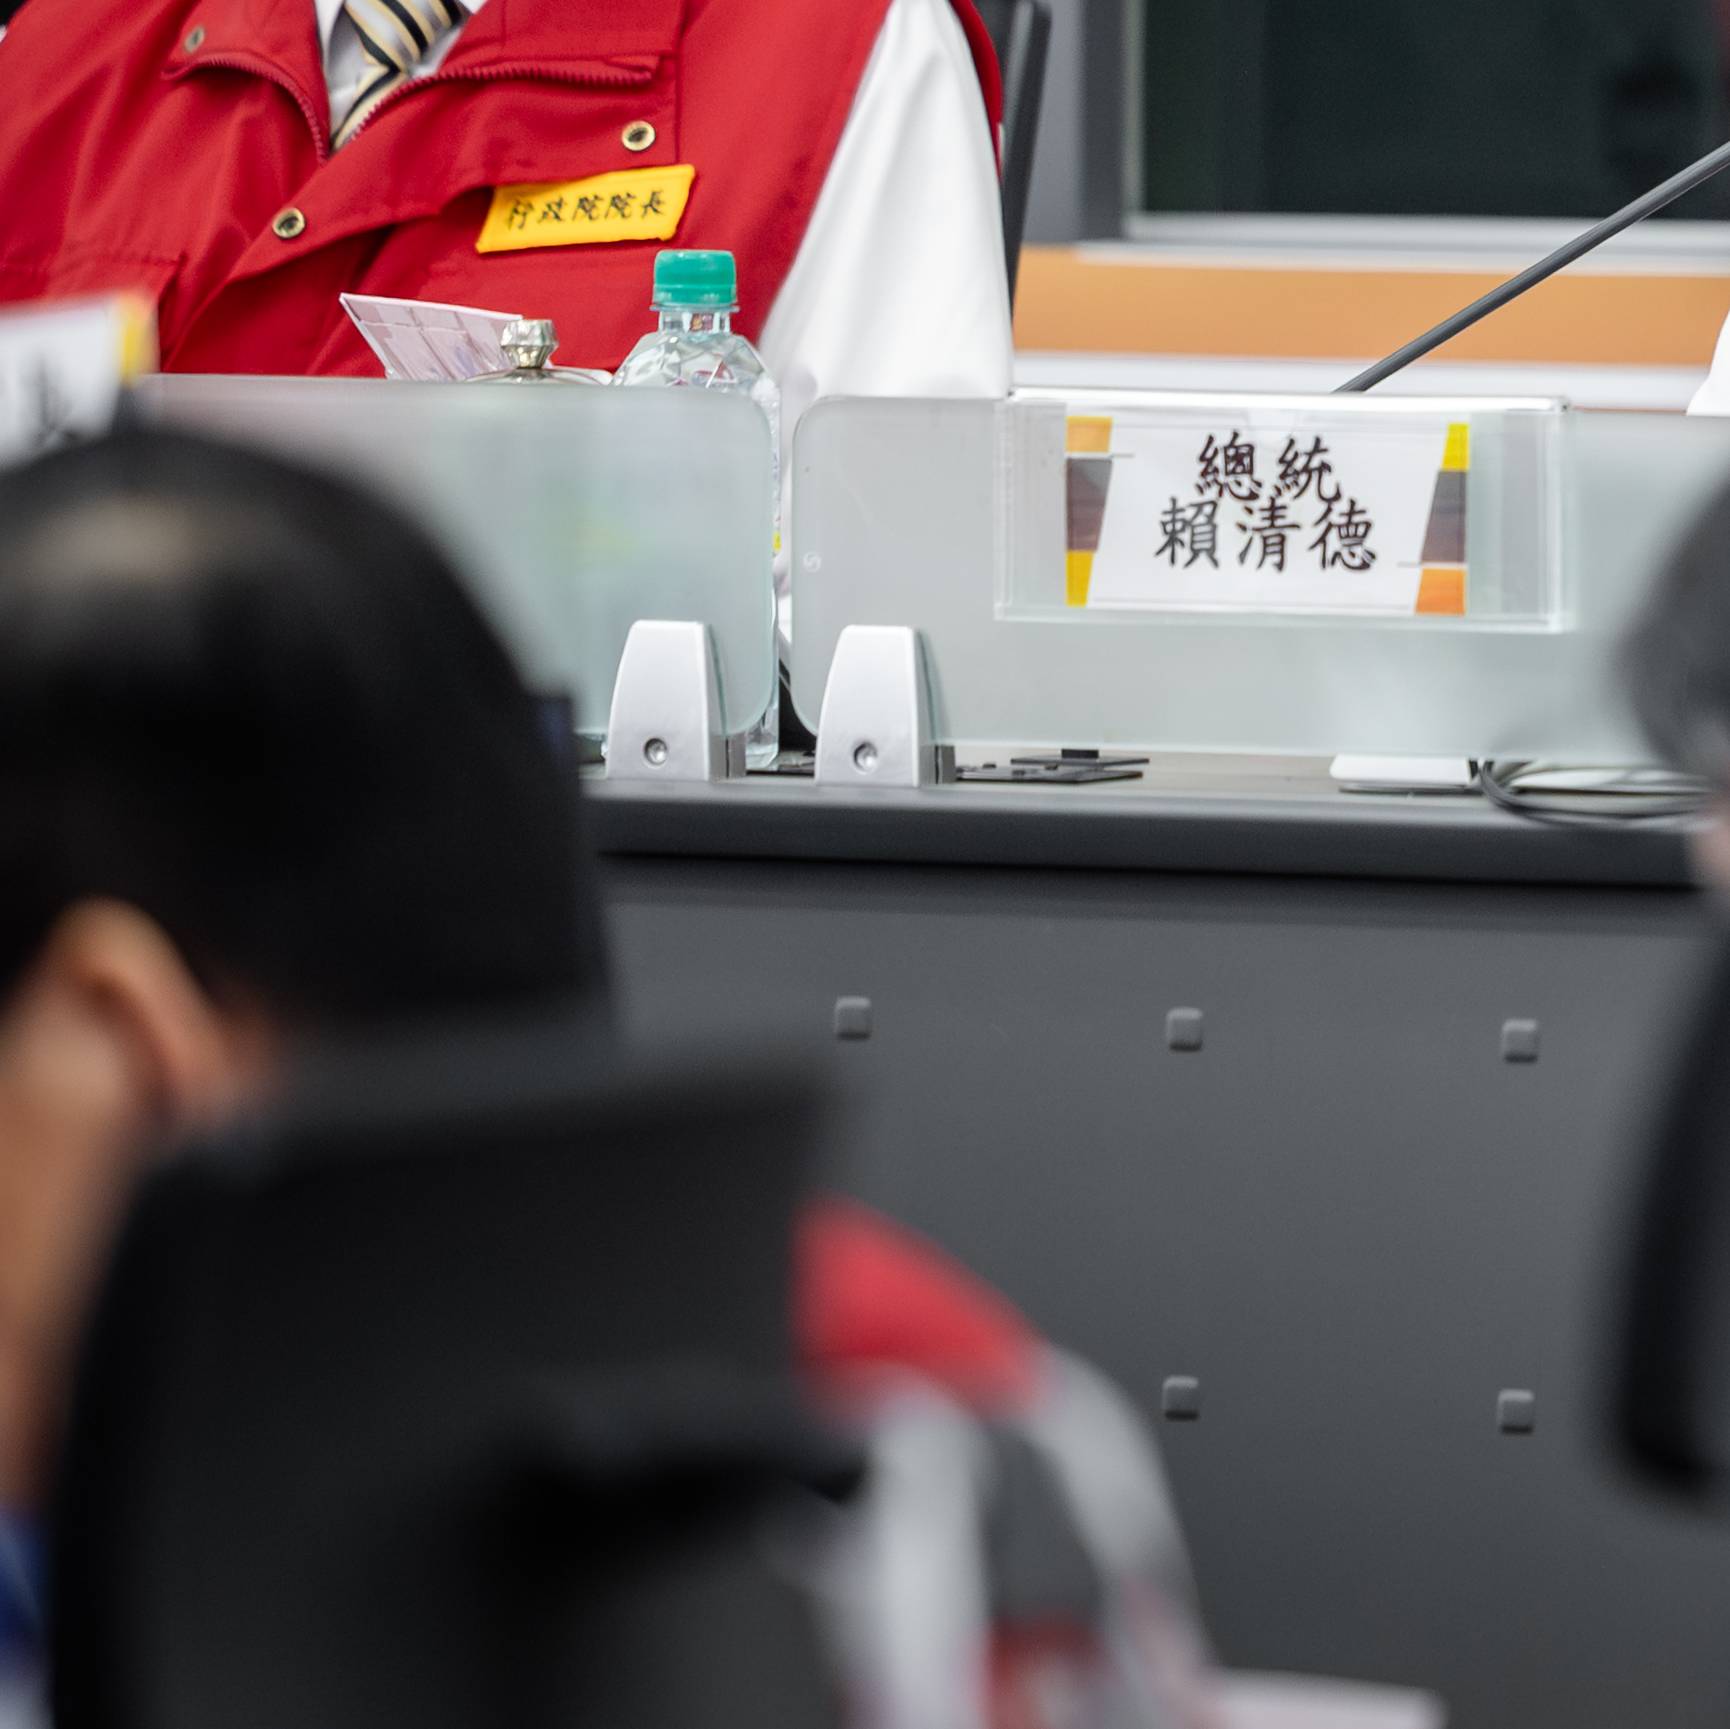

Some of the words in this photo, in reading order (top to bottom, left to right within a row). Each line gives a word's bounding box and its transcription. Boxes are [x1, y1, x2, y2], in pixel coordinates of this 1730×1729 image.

[507, 188, 665, 231] 行政院院長
[1195, 430, 1342, 502] 總統
[1155, 496, 1377, 573] 賴清德
